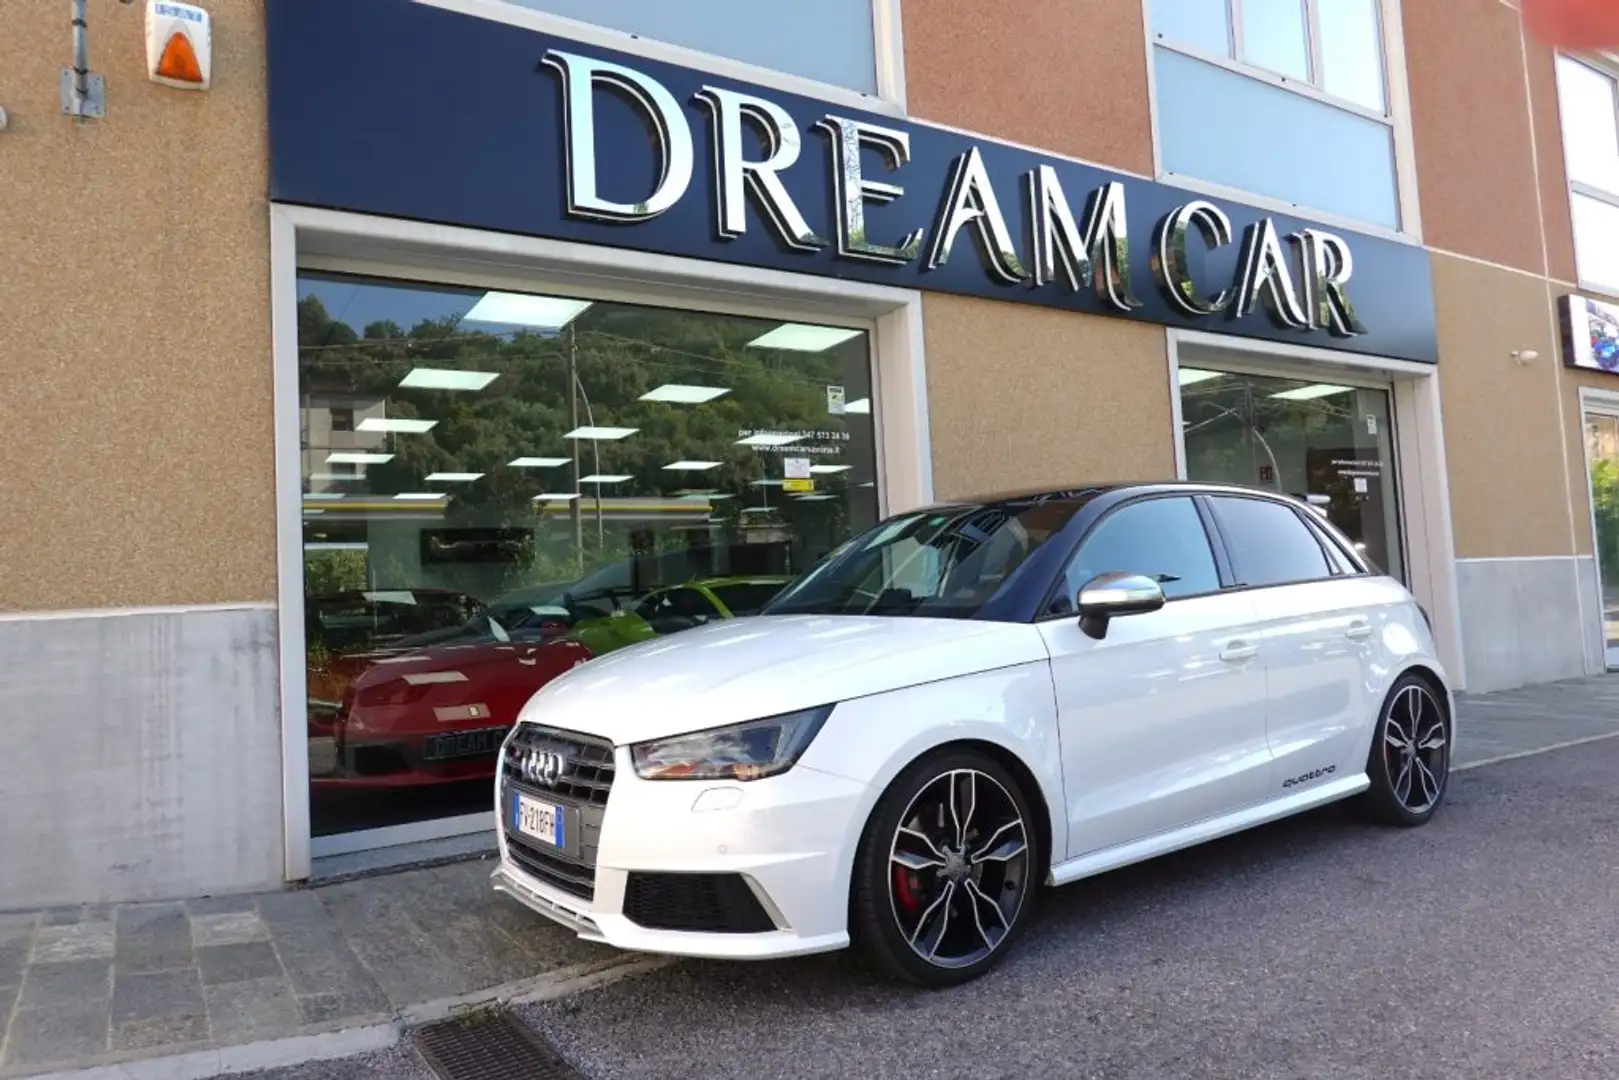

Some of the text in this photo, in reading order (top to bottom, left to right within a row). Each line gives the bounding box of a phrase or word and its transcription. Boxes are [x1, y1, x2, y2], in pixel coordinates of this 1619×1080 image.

[541, 49, 1367, 337] DREAM CAR
[738, 429, 752, 439] per
[1282, 764, 1336, 788] quattro
